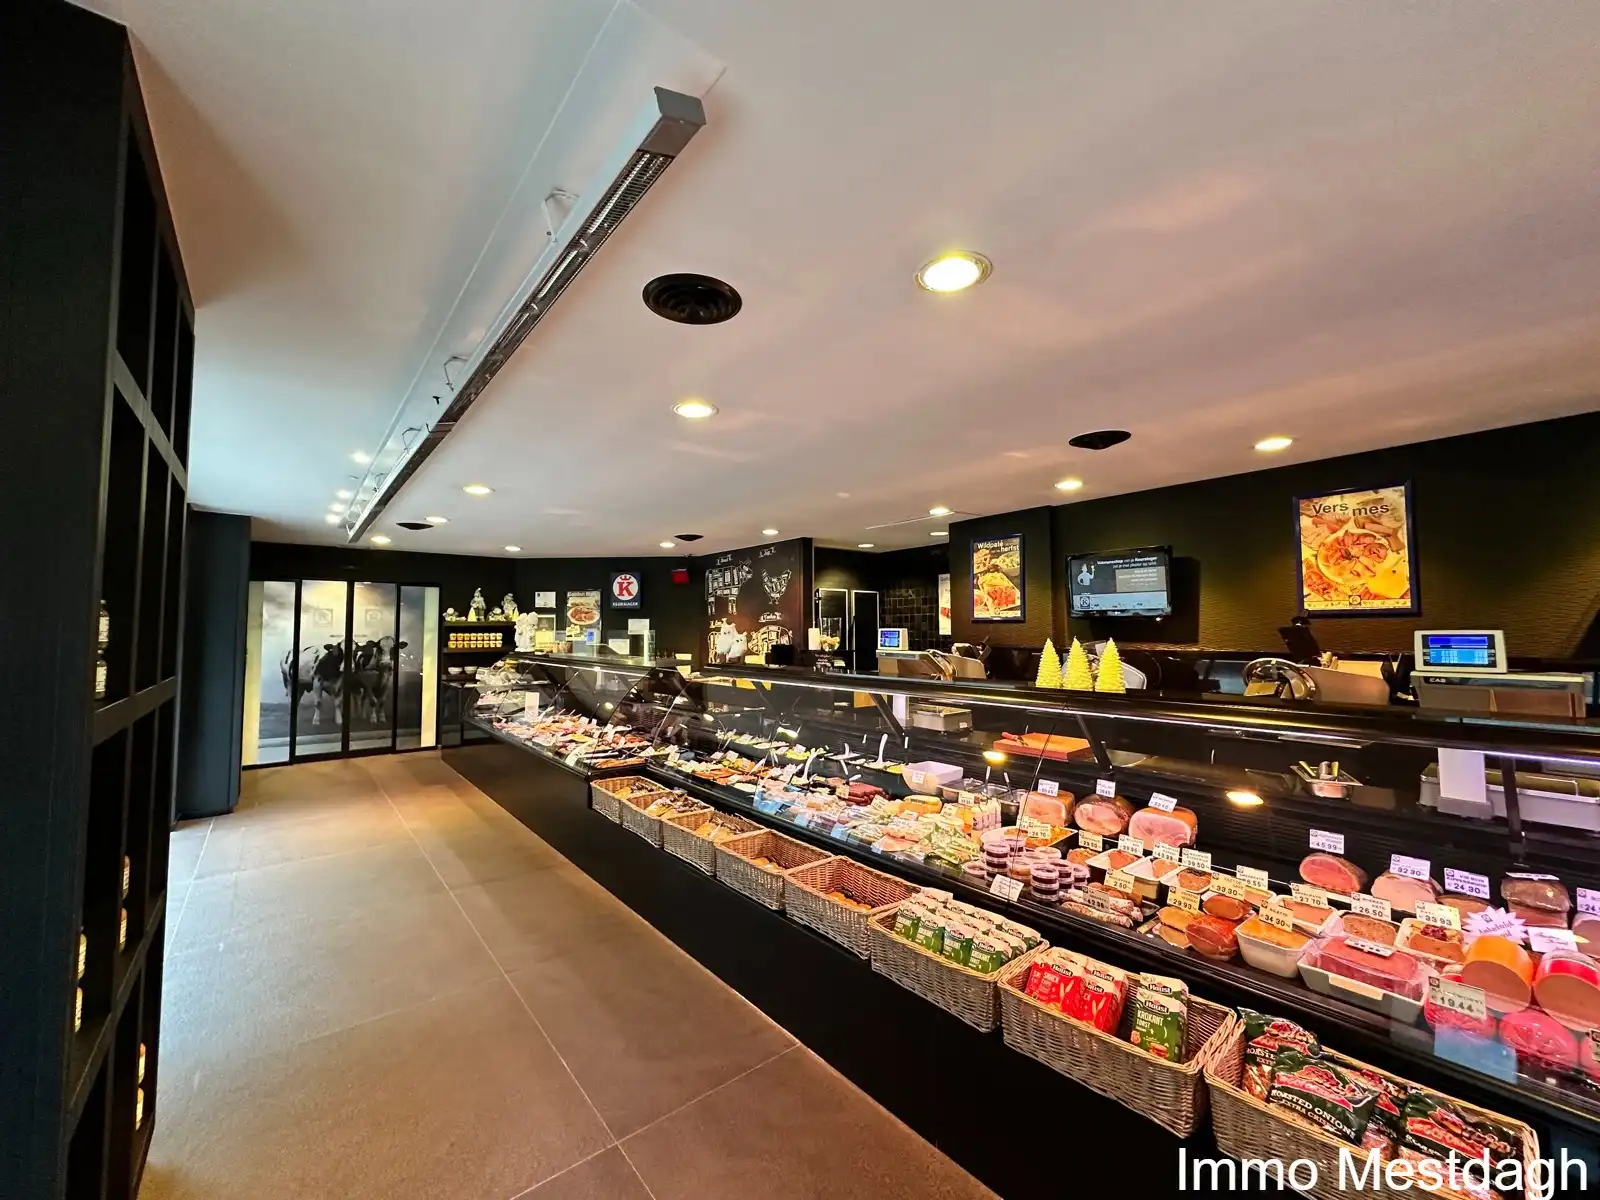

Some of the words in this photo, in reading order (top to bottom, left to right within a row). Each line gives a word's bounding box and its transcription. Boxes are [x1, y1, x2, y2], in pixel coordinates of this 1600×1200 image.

[1312, 502, 1349, 515] Vers
[1352, 504, 1390, 517] mes
[1000, 545, 1020, 553] herfst
[617, 581, 634, 597] K
[1086, 983, 1104, 994] aust
[1271, 1089, 1313, 1111] ROASTED
[1313, 1107, 1356, 1141] ONIONS
